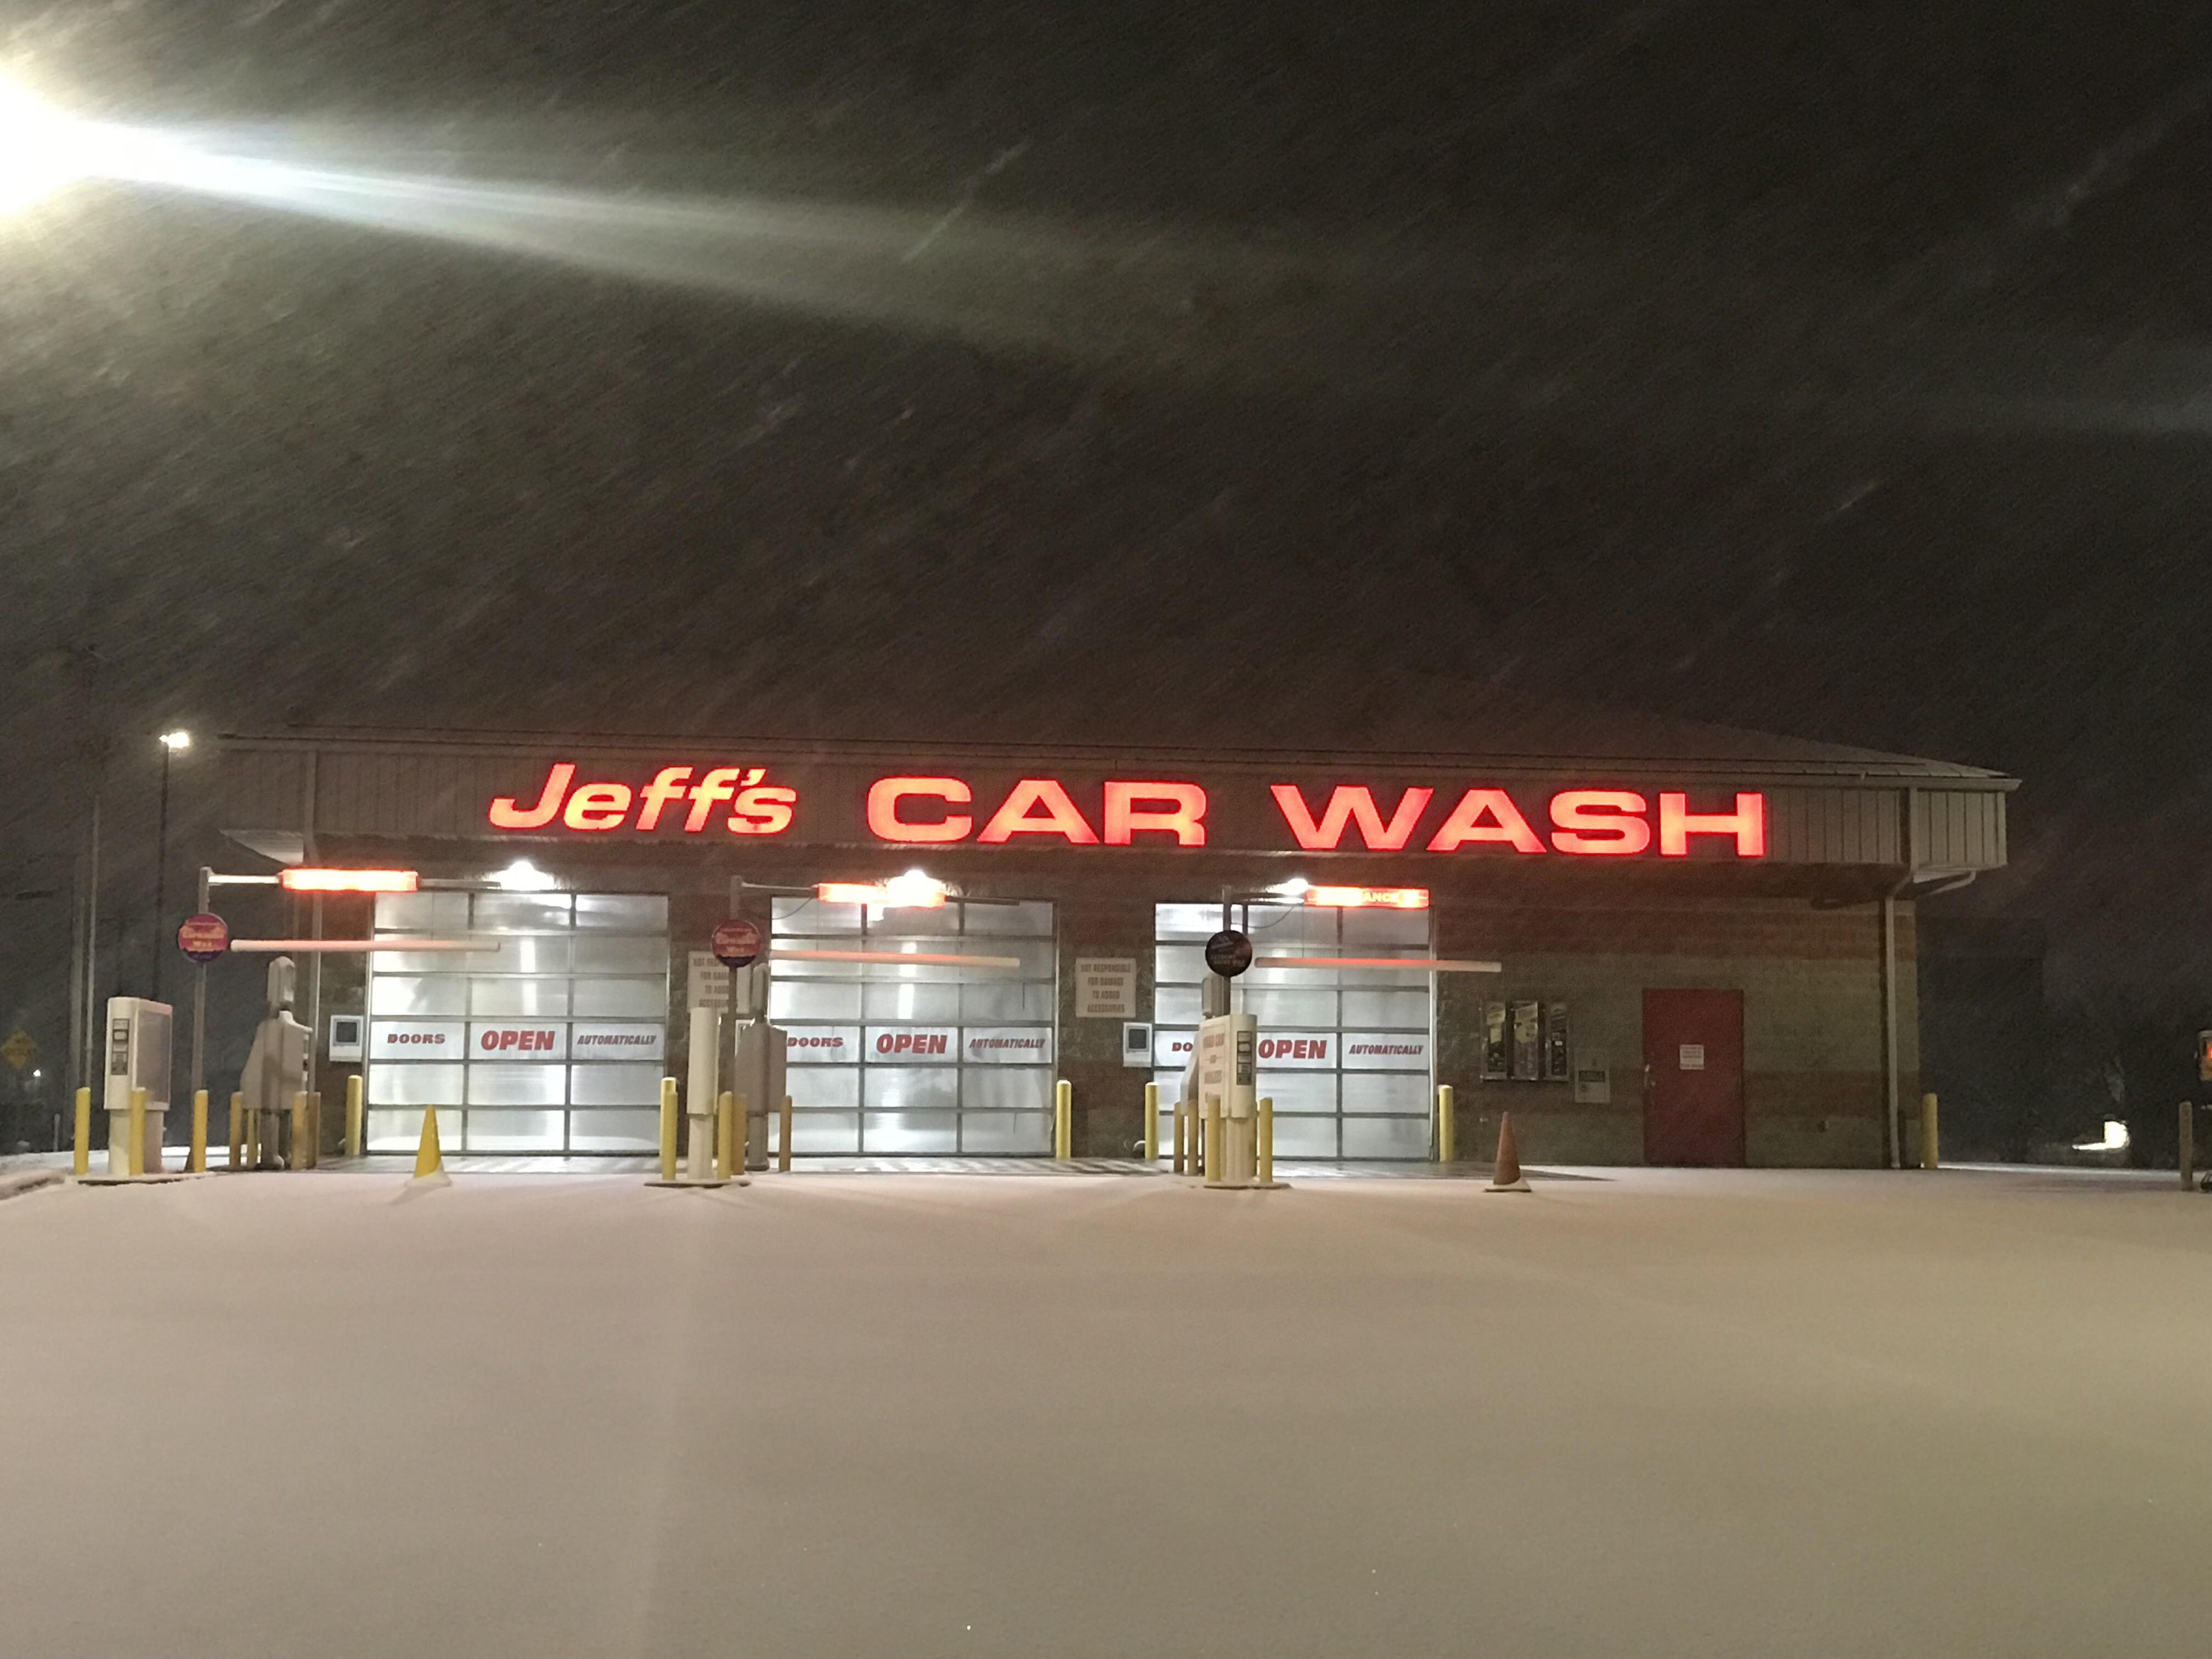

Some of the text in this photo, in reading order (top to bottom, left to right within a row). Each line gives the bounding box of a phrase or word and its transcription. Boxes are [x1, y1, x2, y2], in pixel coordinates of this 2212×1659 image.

[489, 762, 1765, 856] Jeff's CAR WASH
[387, 1030, 657, 1051] DOORS OPEN AUTOMATICALLY
[787, 1034, 1046, 1054] DOORS OPEN AUTOMATICALLY
[1258, 1040, 1425, 1059] OPEN AUTOMATICALLY
